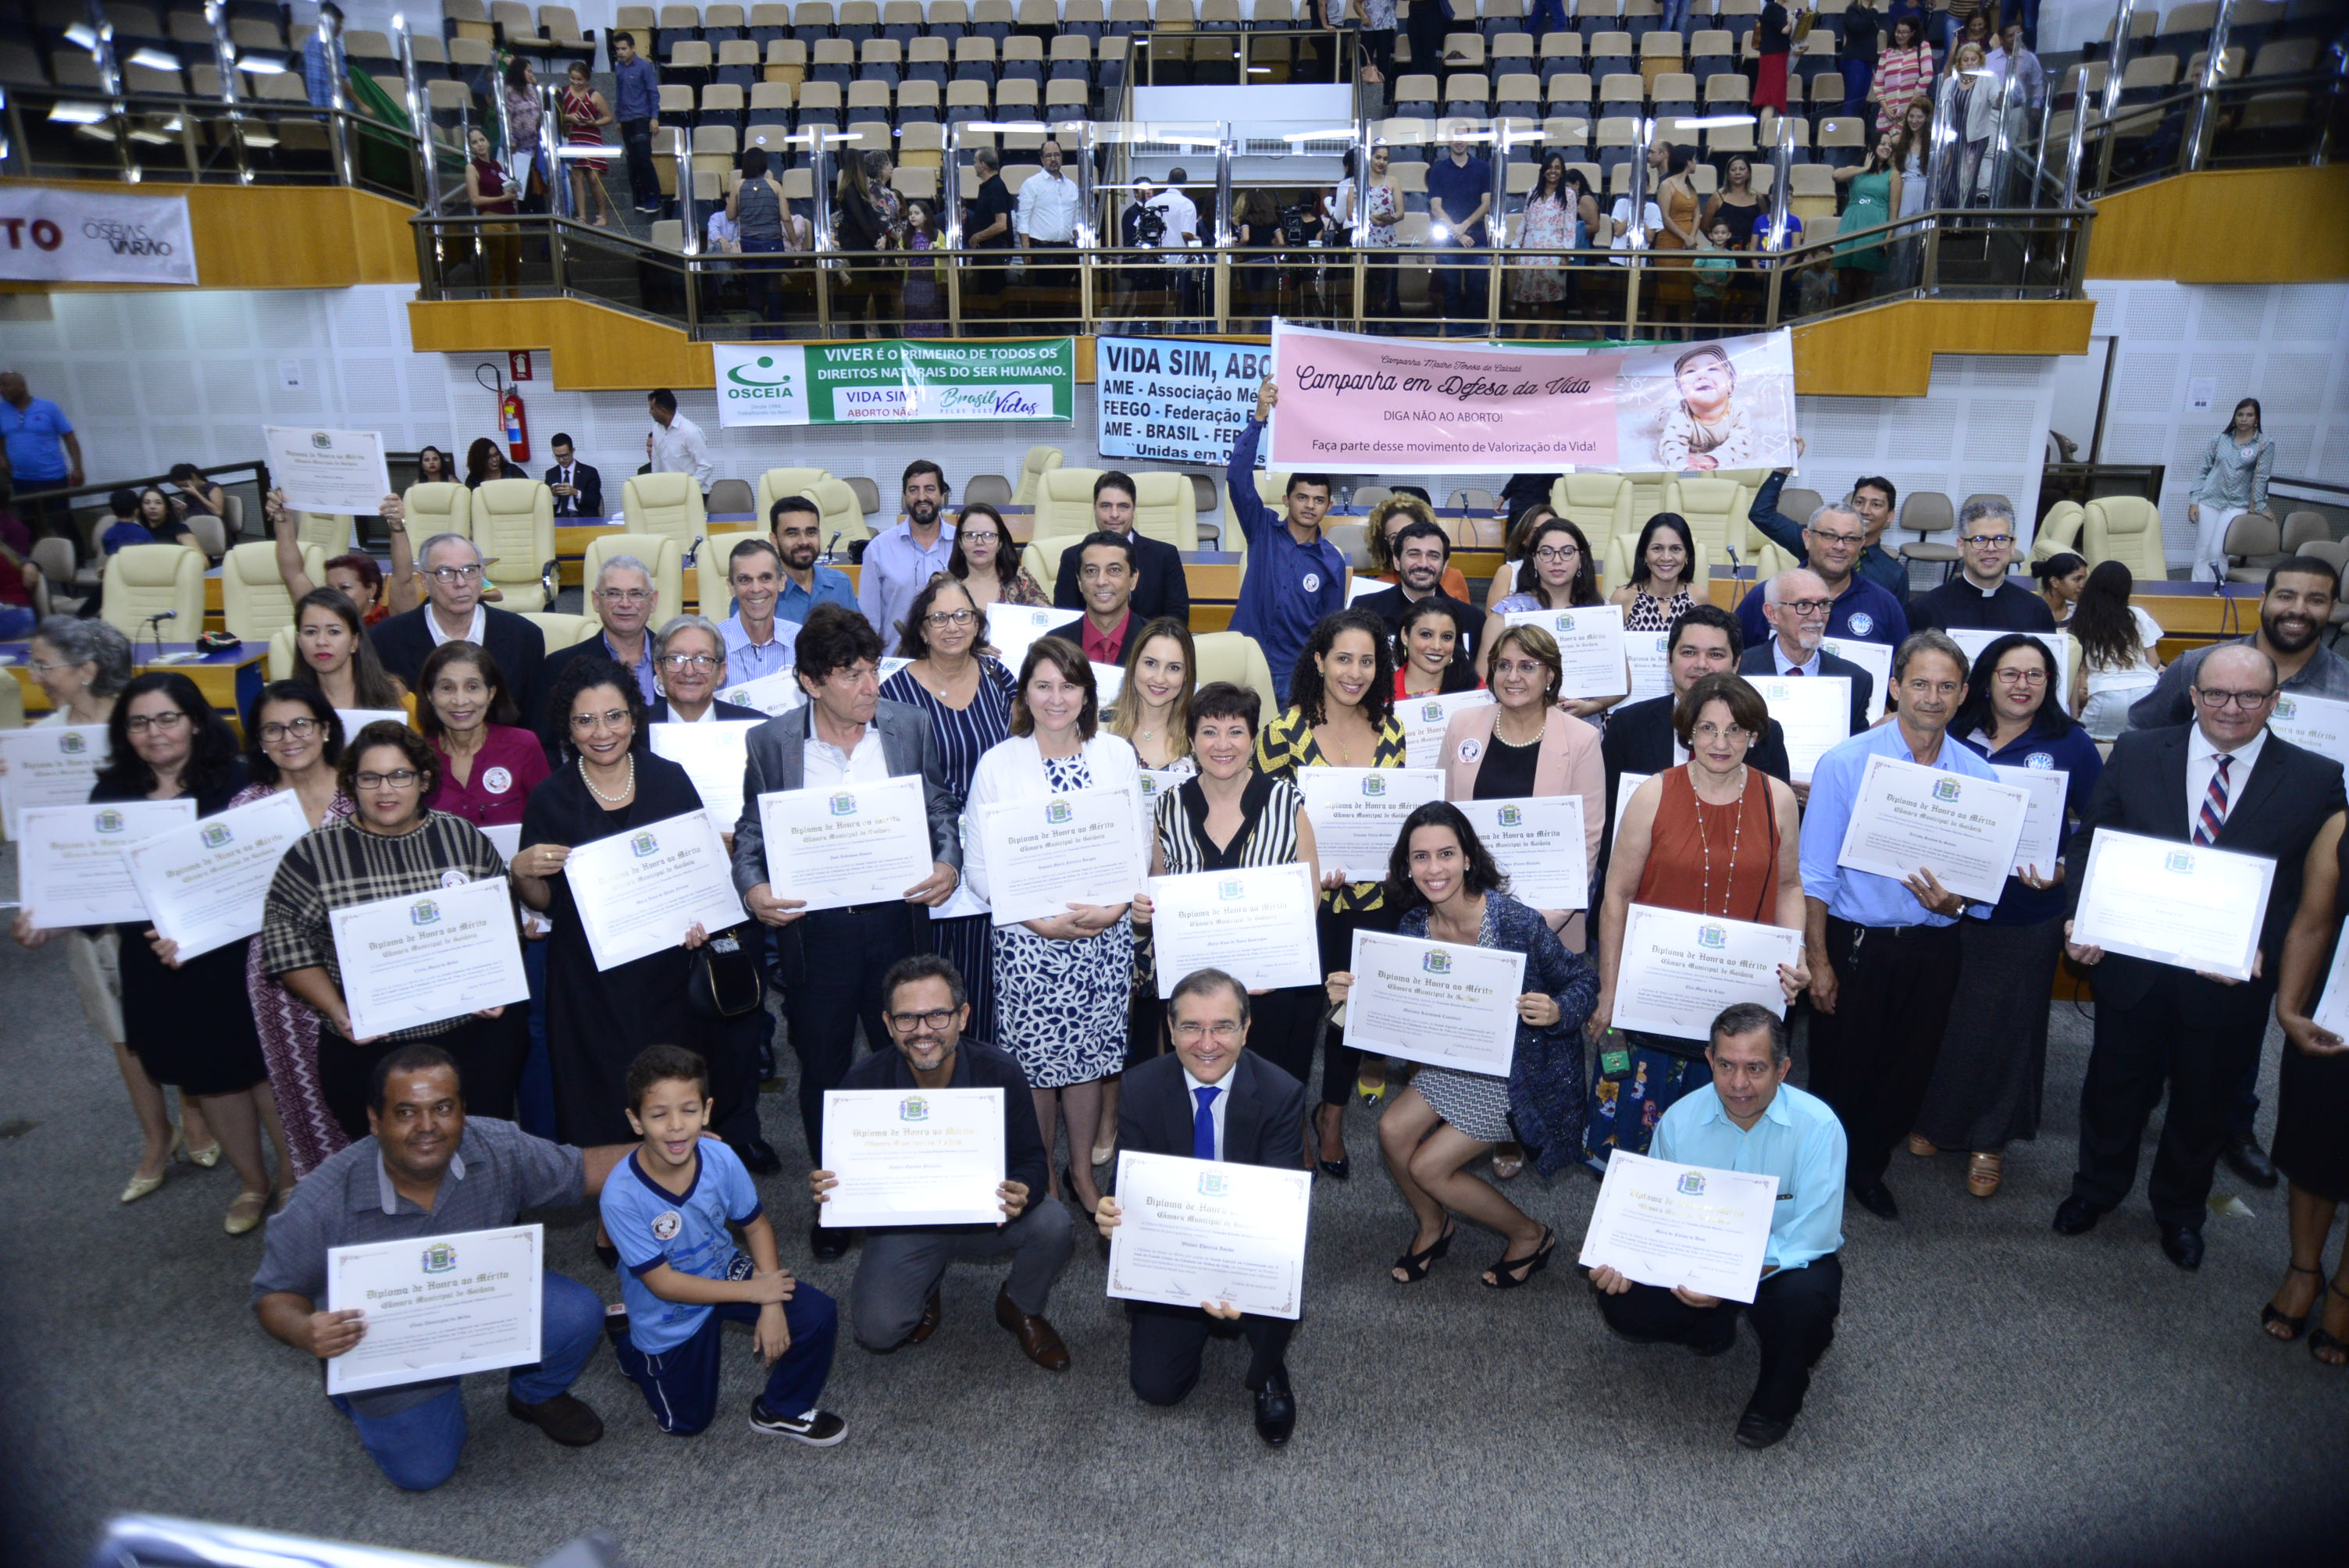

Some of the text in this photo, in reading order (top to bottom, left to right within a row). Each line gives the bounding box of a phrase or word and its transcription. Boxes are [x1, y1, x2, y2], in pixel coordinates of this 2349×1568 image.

[825, 347, 1057, 362] VIVER É O PRIMEIRO DE TODOS OS
[1107, 346, 1161, 374] VIDA
[1169, 349, 1217, 383] SIM,
[1381, 355, 1421, 366] Campanha
[1424, 359, 1453, 369] Madre
[1453, 362, 1481, 371] Teresa
[818, 365, 1067, 380] DIREITOS NATURAIS DO SER HUMANO.
[1296, 365, 1591, 401] Campanha em Defesa da Vida
[728, 387, 793, 399] OSCEIA
[847, 391, 882, 403] VIDA
[940, 387, 996, 408] Brasil
[993, 390, 1039, 415] Vidas
[1104, 380, 1135, 395] AME
[1147, 382, 1232, 404] Associação
[847, 408, 890, 417] ABORTO
[1104, 401, 1151, 417] FEEGO
[1164, 404, 1241, 425] Federação
[1384, 410, 1503, 422] DIGA NÃO AO ABORTO!
[1104, 422, 1132, 437] AME
[1146, 424, 1200, 442] BRASIL
[1194, 449, 1217, 460] em
[1312, 440, 1596, 454] Faça parte desse movimento de Valorização da Vida!
[1885, 793, 1918, 808] Diploma
[1930, 804, 1955, 817] Honra
[1969, 813, 1996, 826] Mérito
[1007, 833, 1039, 845] Diploma
[1050, 826, 1076, 837] Honra
[1088, 820, 1114, 831] Mérito
[1536, 829, 1560, 837] Mérito
[368, 936, 404, 950] Diploma
[417, 927, 444, 939] Honra
[458, 918, 487, 930] Mérito
[1651, 944, 1684, 958] Diploma
[1698, 953, 1725, 964] Honra
[1738, 959, 1767, 971] Mérito
[1376, 970, 1410, 983] Diploma
[1424, 978, 1451, 989] Honra
[1464, 983, 1494, 995] Mérito
[365, 1285, 408, 1299] Diploma
[412, 1284, 422, 1292] de
[426, 1278, 458, 1290] Honra
[476, 1270, 509, 1282] Mérito
